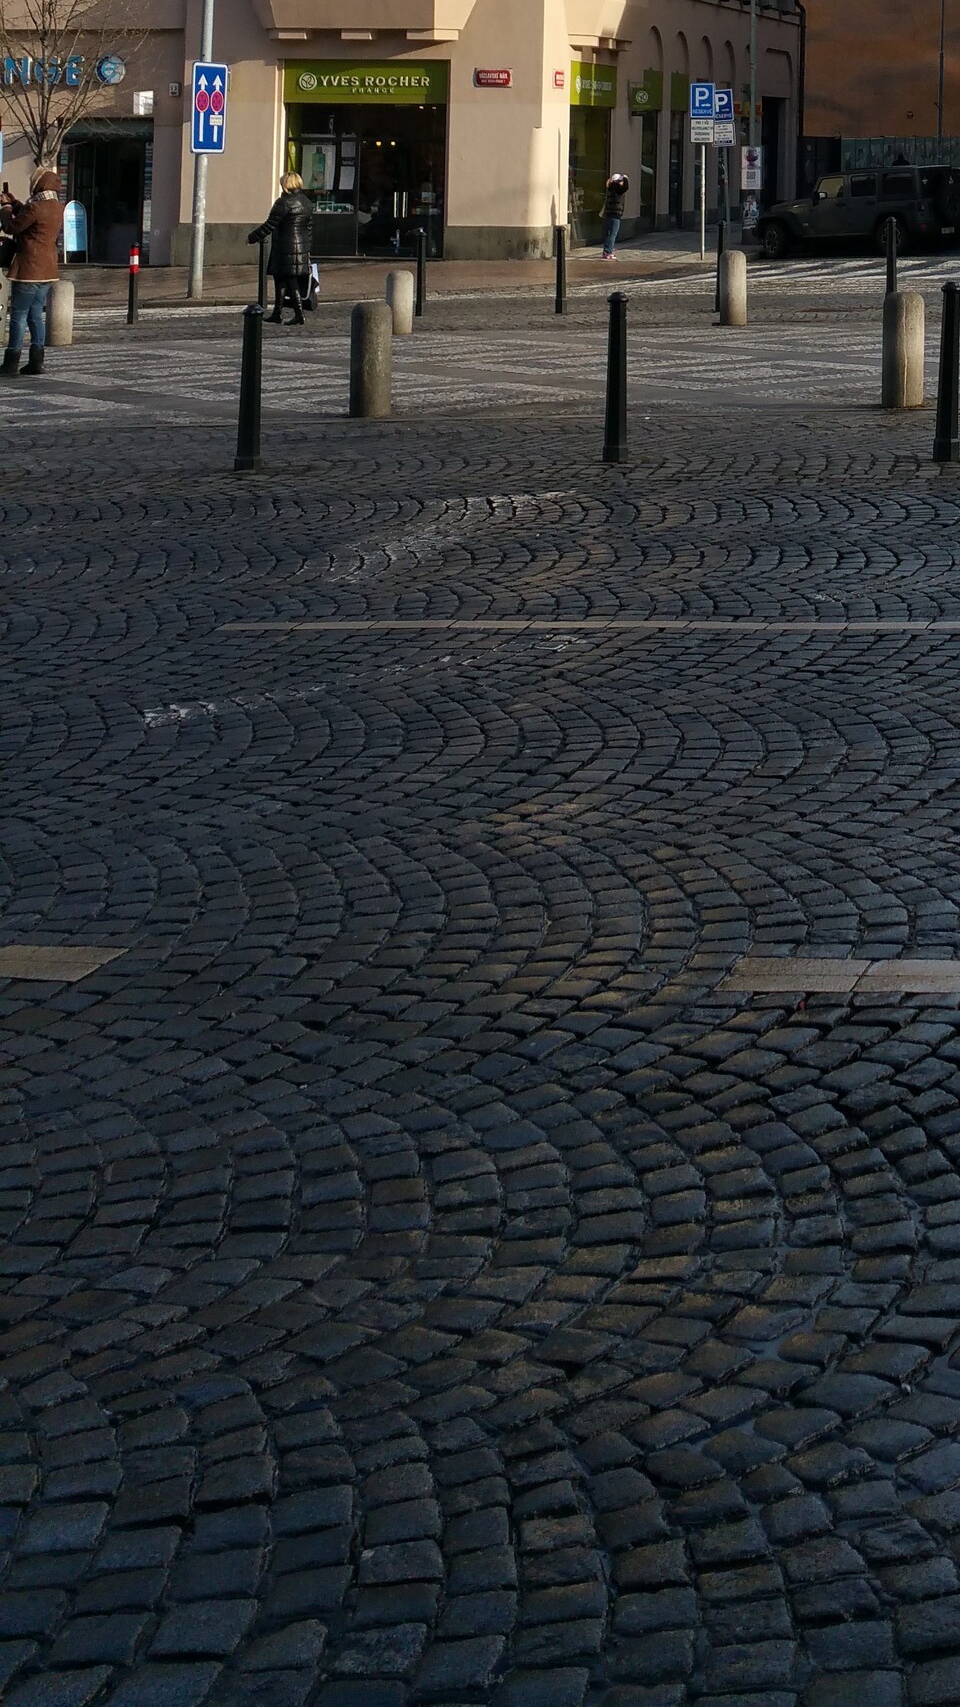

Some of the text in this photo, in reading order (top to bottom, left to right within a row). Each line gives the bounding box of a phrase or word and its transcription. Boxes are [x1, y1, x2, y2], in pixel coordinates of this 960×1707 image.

[0, 55, 84, 86] NGE
[320, 75, 430, 87] YVES ROCHER
[695, 87, 710, 107] P
[714, 93, 728, 112] P
